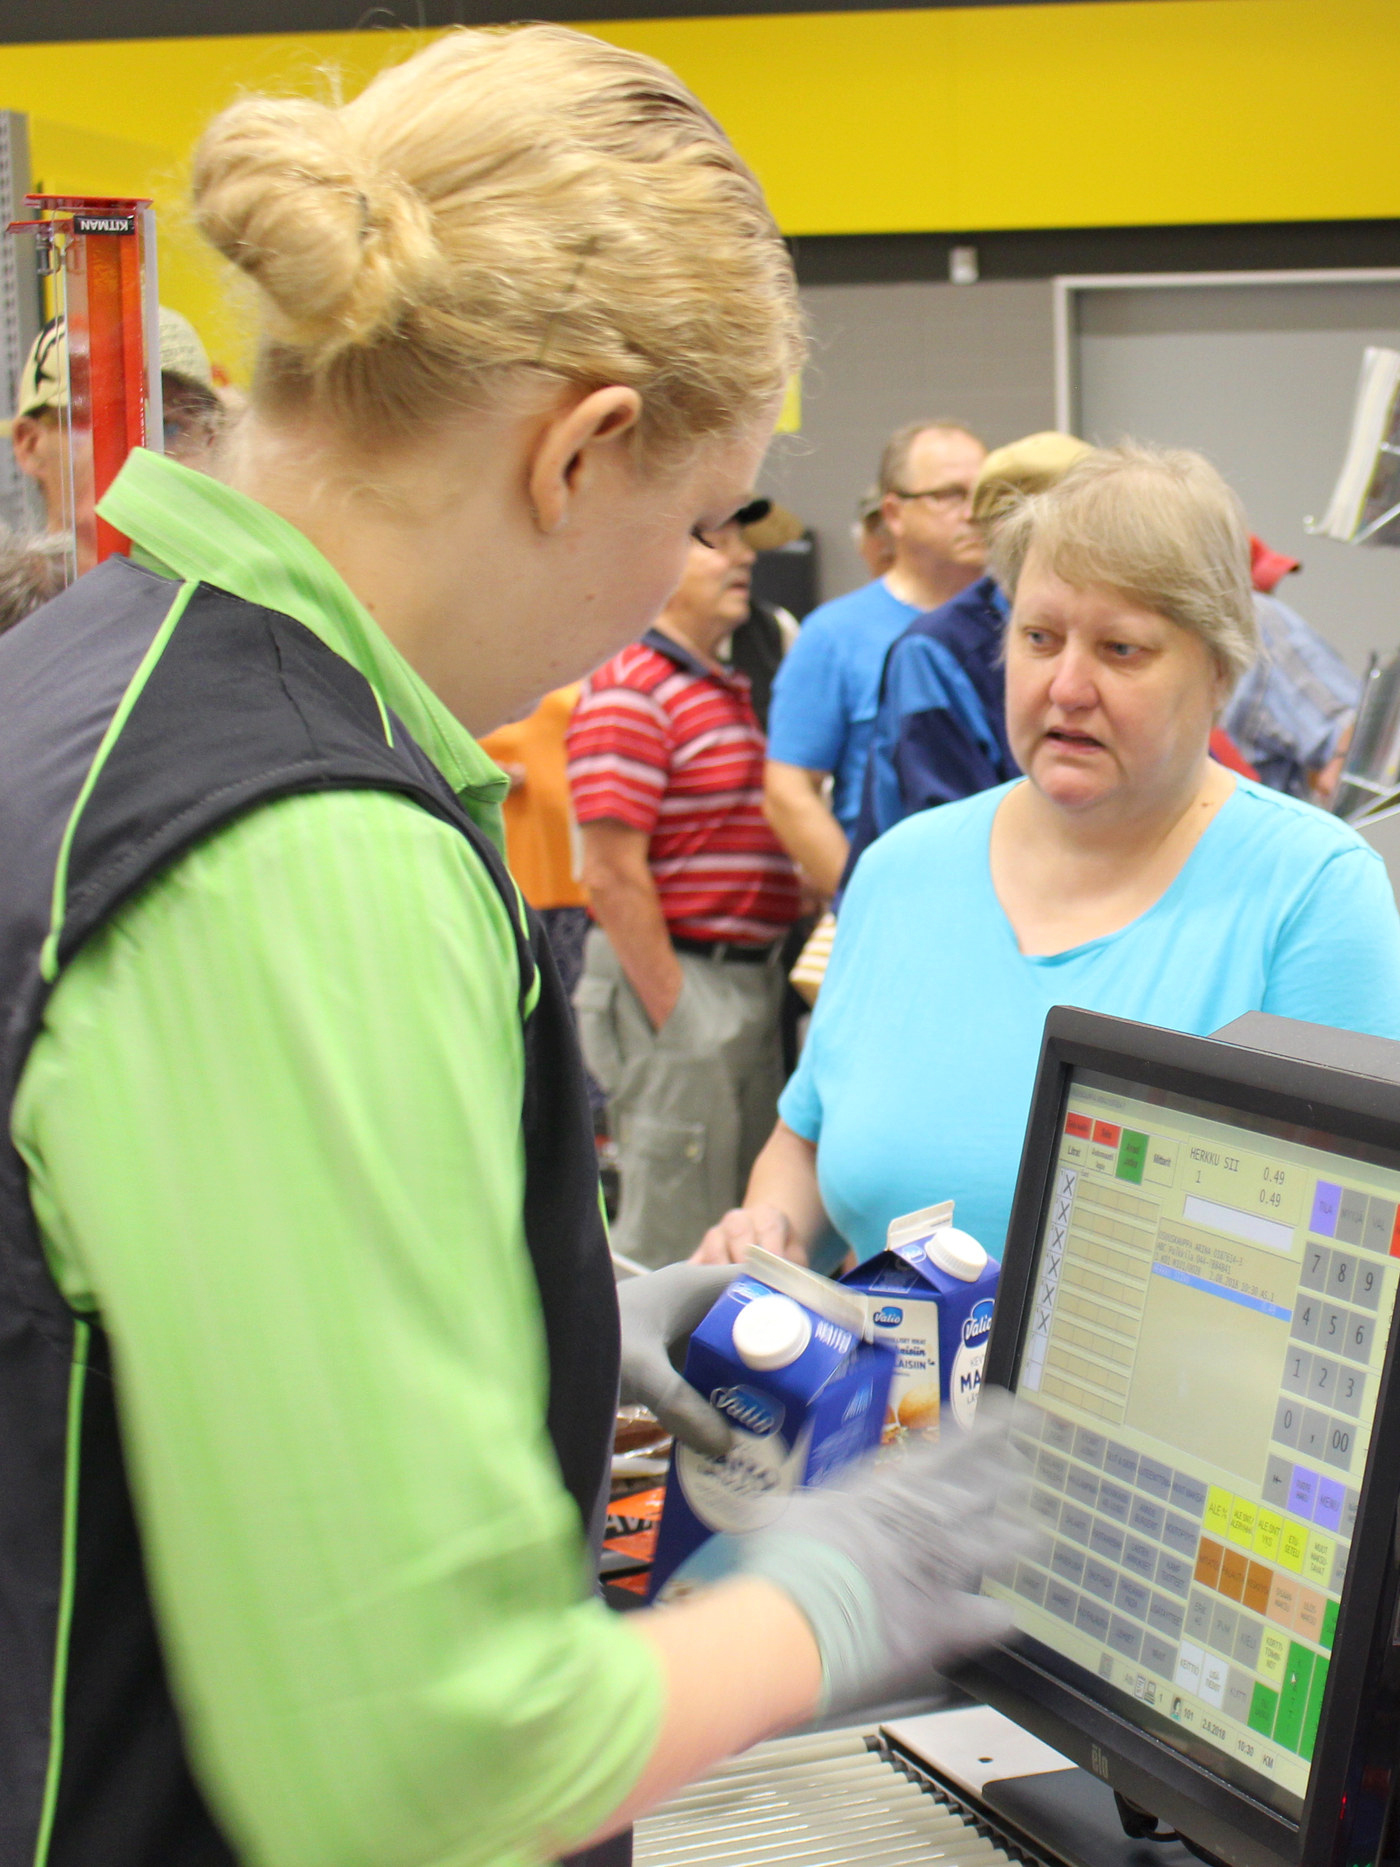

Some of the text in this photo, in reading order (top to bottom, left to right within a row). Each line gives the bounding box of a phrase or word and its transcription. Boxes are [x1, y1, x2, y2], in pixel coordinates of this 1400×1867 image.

[80, 219, 129, 231] KITMAN
[1189, 1147, 1285, 1185] HERKKU SII 0.49
[1195, 1170, 1281, 1207] 1 0.49
[1311, 1253, 1320, 1273] 7
[1337, 1262, 1347, 1283] 8
[1363, 1271, 1374, 1292] 9
[874, 1311, 901, 1324] Valio
[1301, 1305, 1311, 1326] 4
[1327, 1314, 1337, 1335] 5
[1354, 1324, 1364, 1345] 6
[1292, 1357, 1302, 1378] 1
[1318, 1367, 1328, 1388] 2
[1345, 1377, 1355, 1398] 3
[1282, 1408, 1293, 1430] 0
[1331, 1428, 1350, 1453] 00
[1182, 1707, 1194, 1722] 101
[1201, 1718, 1226, 1741] 2.8.2018
[1237, 1739, 1254, 1757] 10:30
[1262, 1754, 1273, 1769] KM
